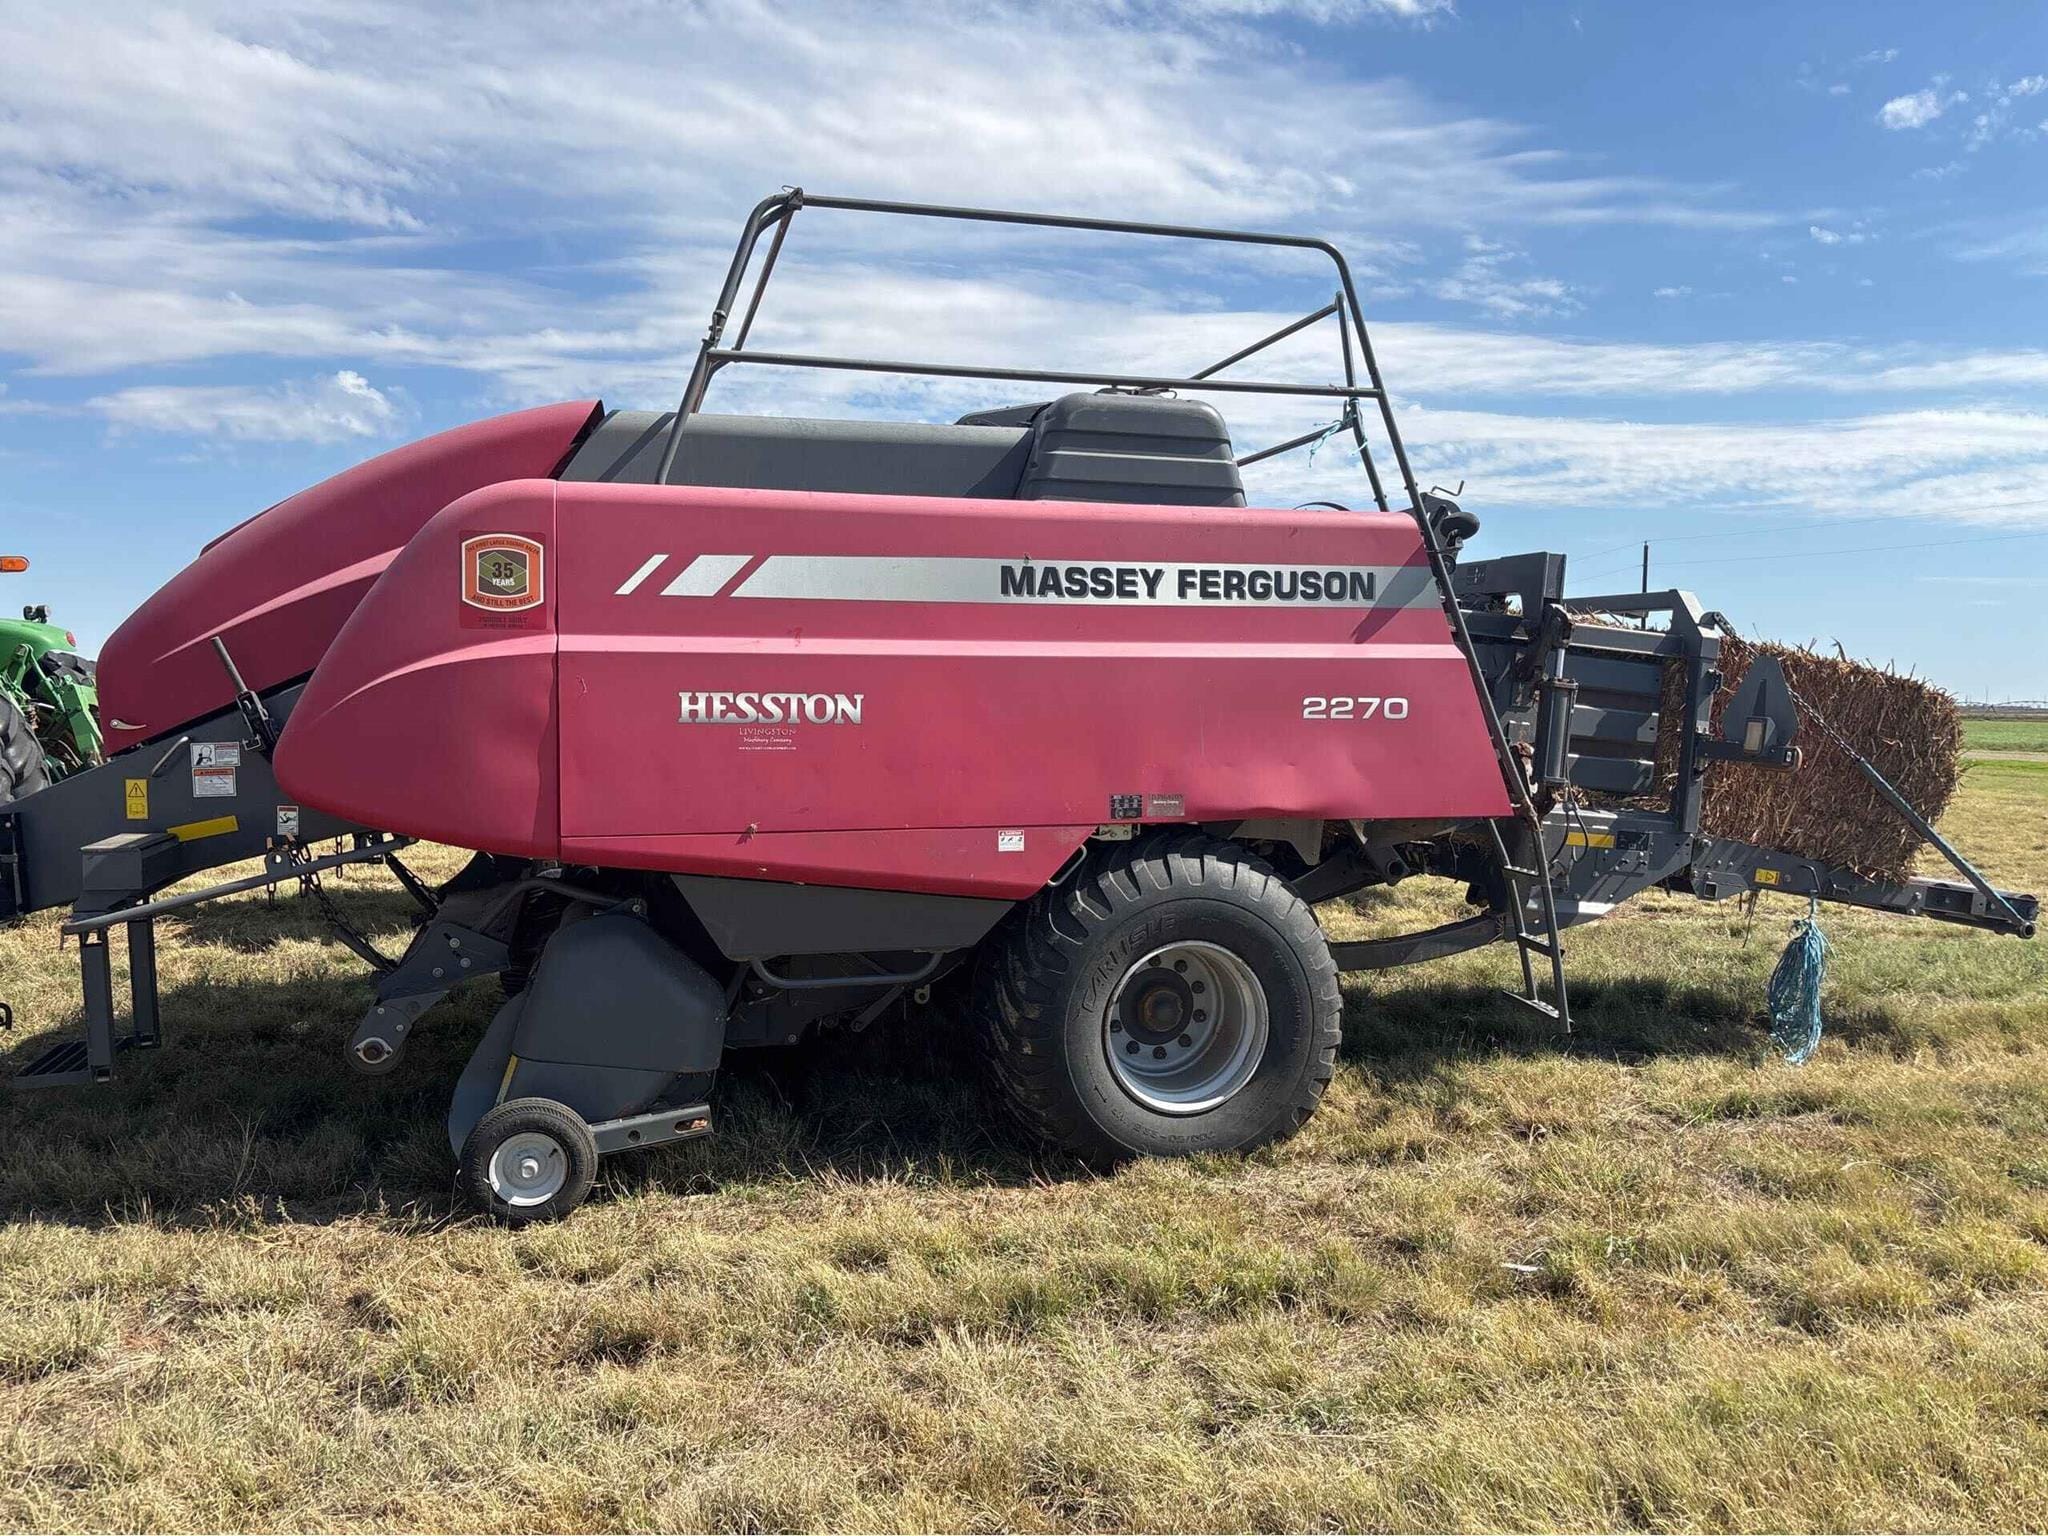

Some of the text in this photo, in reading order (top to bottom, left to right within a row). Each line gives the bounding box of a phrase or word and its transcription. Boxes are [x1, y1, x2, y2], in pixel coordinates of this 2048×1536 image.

[492, 562, 514, 579] 35
[492, 577, 516, 586] YEARS
[1000, 565, 1376, 602] MASSEY FERGUSON
[486, 597, 503, 607] STILL
[504, 599, 517, 607] THE
[518, 595, 534, 605] BEST
[678, 692, 865, 725] HESSTON
[1302, 697, 1409, 720] 2270
[739, 727, 796, 736] LIVINGSTON
